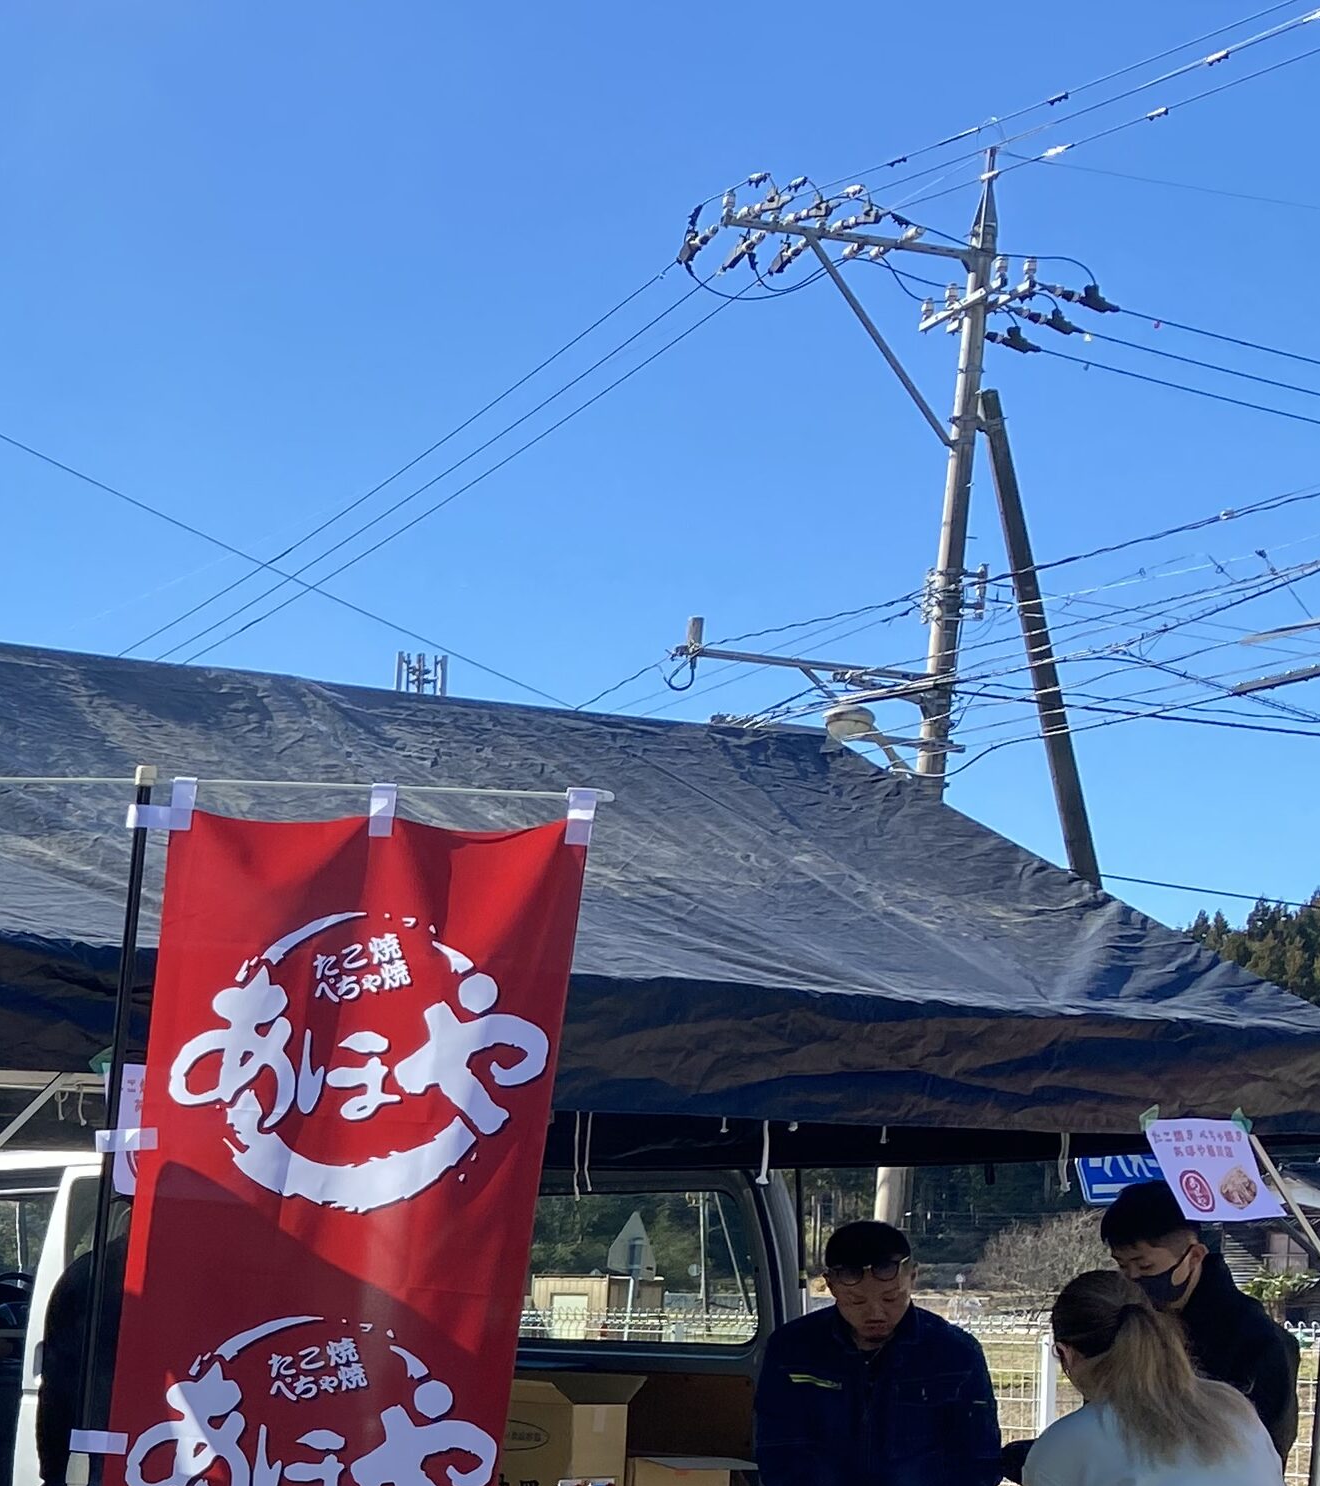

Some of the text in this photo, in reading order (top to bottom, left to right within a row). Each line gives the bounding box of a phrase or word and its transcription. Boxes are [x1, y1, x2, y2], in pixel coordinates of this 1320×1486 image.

[313, 932, 402, 980] たこ焼
[169, 965, 550, 1137] あほや
[268, 1337, 360, 1379] たこ焼
